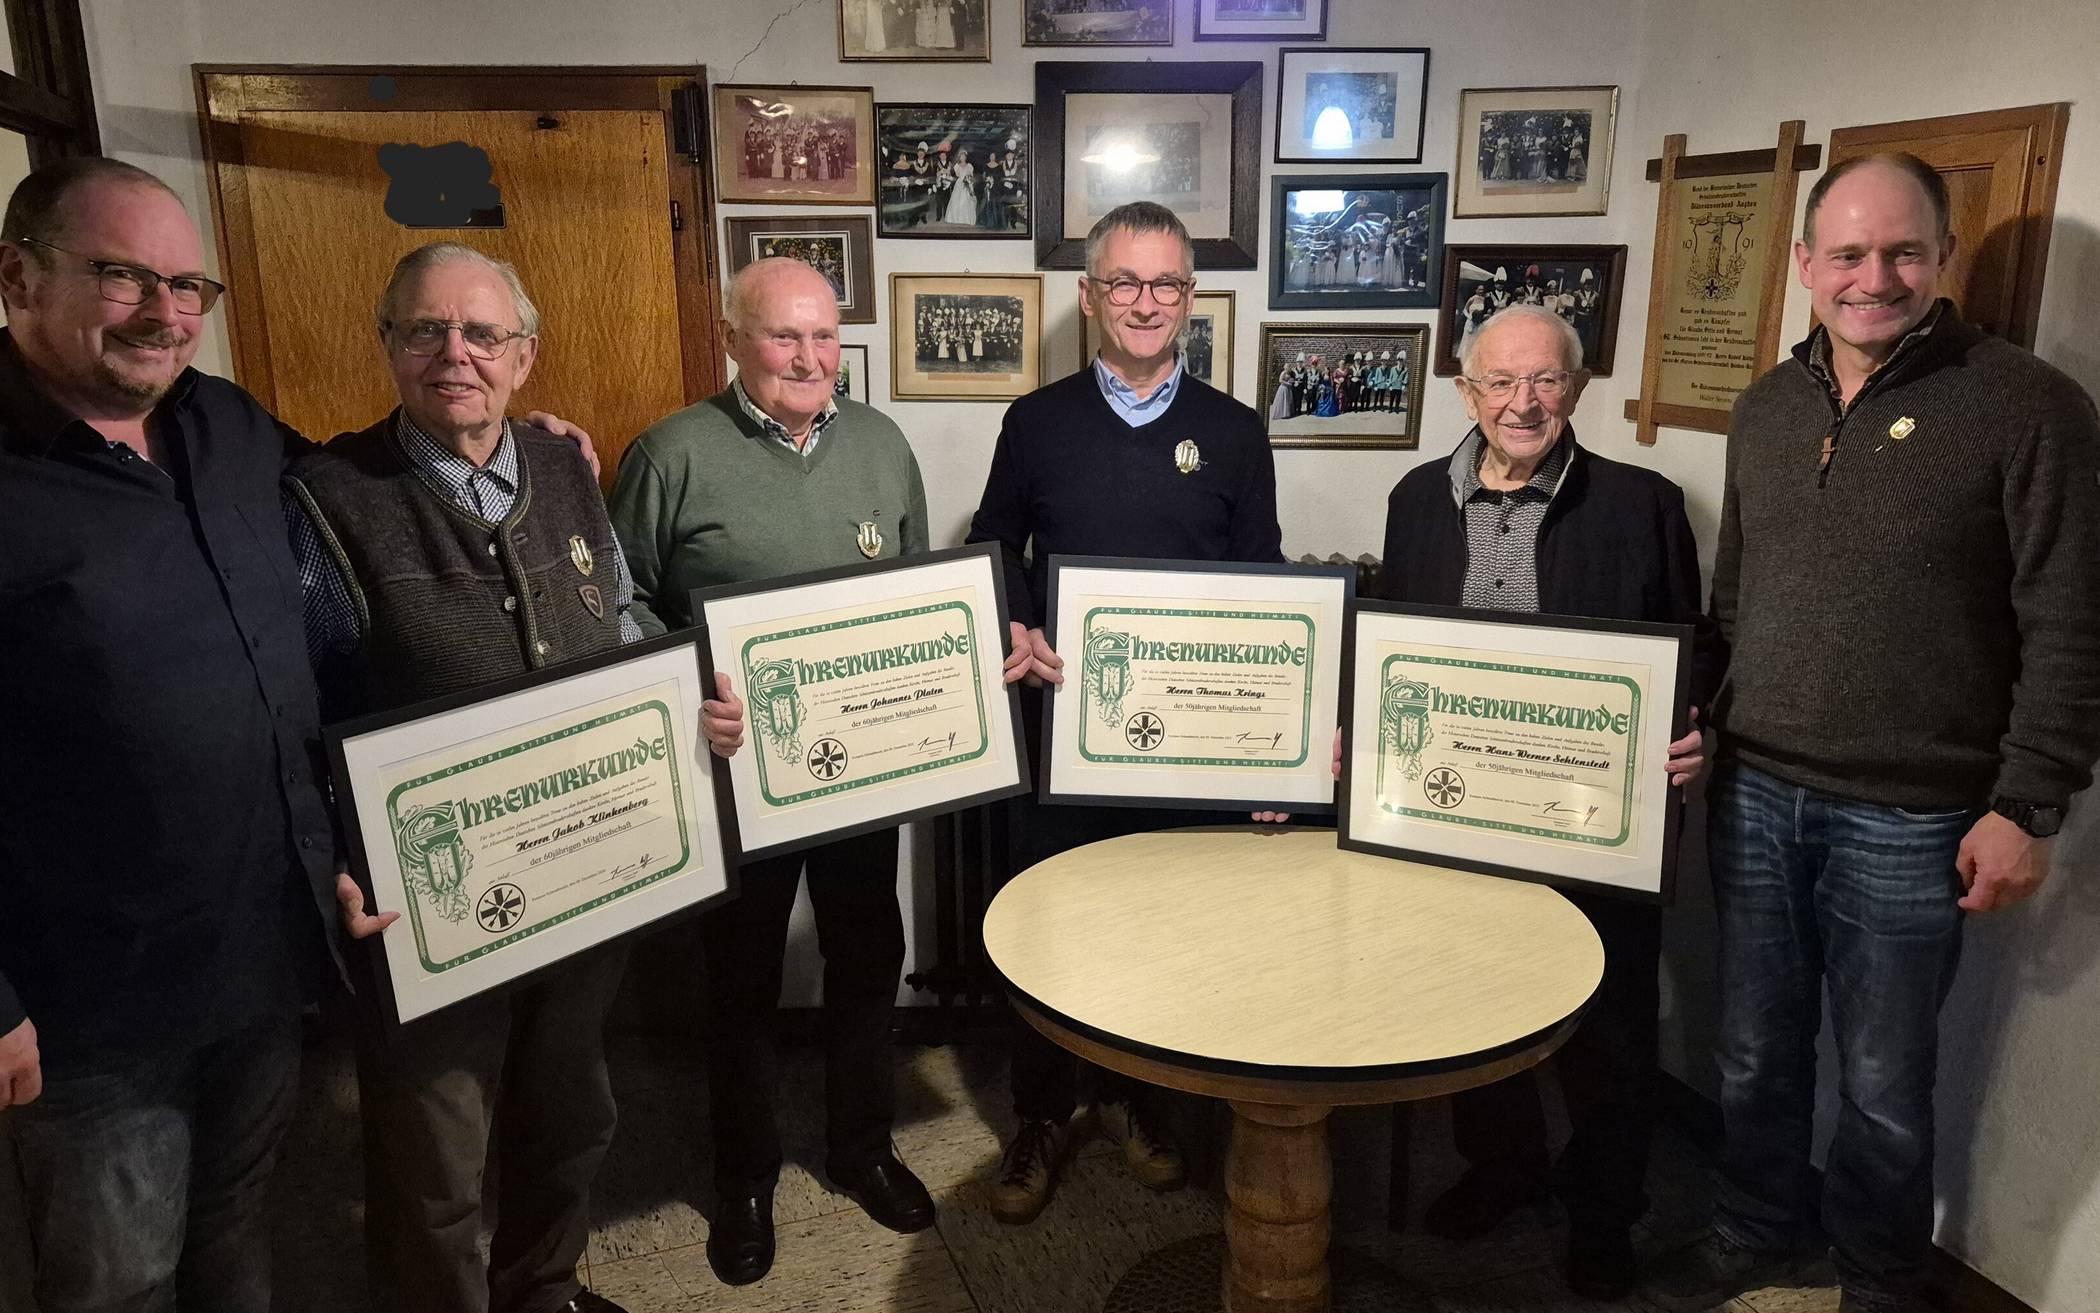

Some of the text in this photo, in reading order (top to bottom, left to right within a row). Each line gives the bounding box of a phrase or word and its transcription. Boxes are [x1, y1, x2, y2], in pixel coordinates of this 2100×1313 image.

[882, 611, 902, 619] UND
[840, 685, 943, 713] Herrn Johannes Platen
[1166, 686, 1265, 699] Herrn Thomas Krings
[895, 704, 937, 718] Mitgliedschaft
[1218, 704, 1261, 712] Mitgliedschaft
[563, 722, 587, 736] UND
[1452, 741, 1481, 751] Herrn
[1484, 745, 1550, 760] Hans-Werner
[903, 766, 922, 775] UND
[1488, 762, 1523, 775] 50jährigen
[1525, 768, 1574, 780] Mitgliedschaft
[515, 834, 550, 850] Herrn
[551, 821, 584, 839] Jakob
[586, 797, 649, 824] Klinkenberg
[1521, 827, 1544, 835] UND
[529, 822, 631, 866] der 60jährigen Mitgliedschaft
[592, 892, 615, 907] UND
